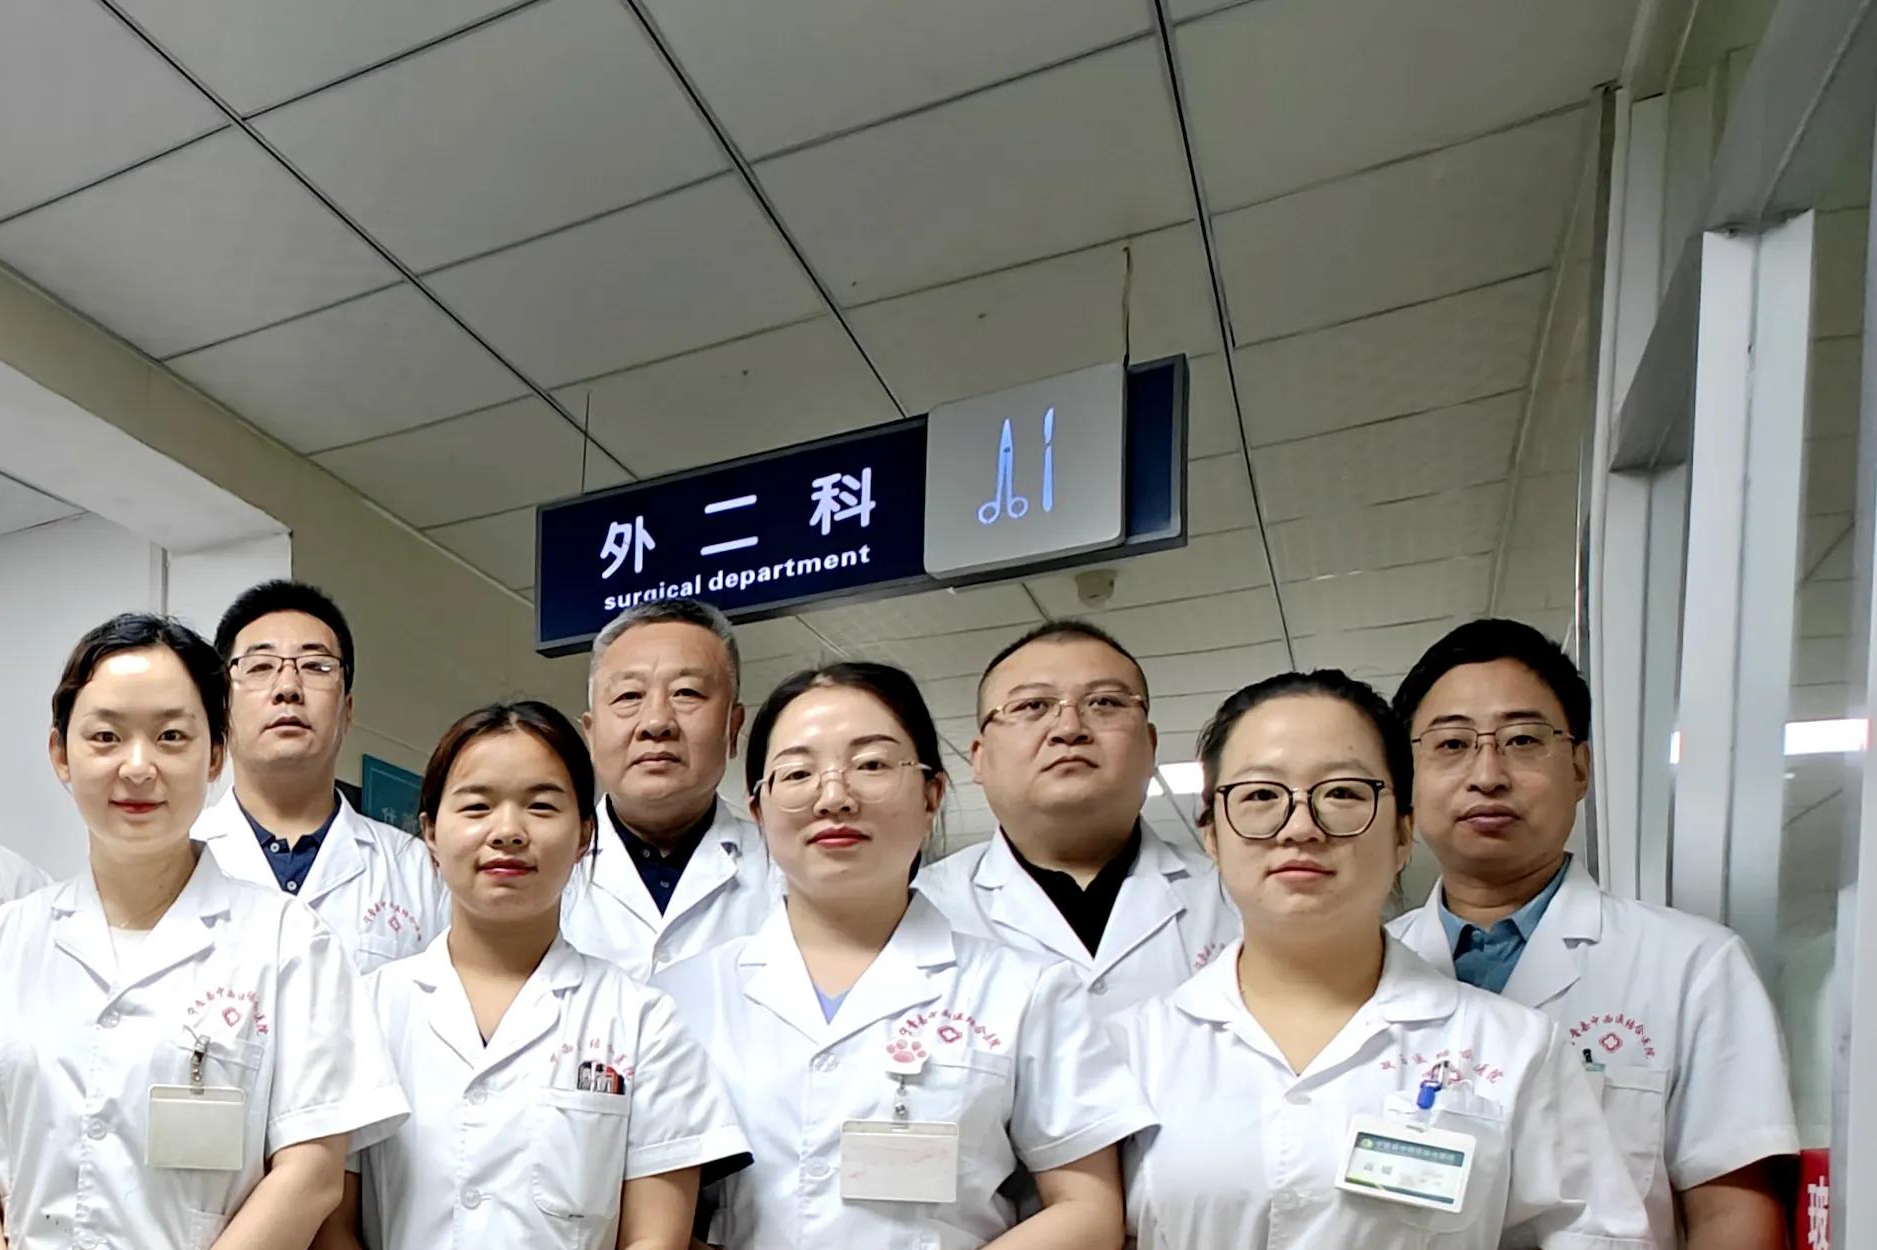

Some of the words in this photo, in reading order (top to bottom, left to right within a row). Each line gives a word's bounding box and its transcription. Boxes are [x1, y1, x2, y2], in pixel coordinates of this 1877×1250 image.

[599, 466, 877, 580] 外二科
[708, 543, 871, 593] department
